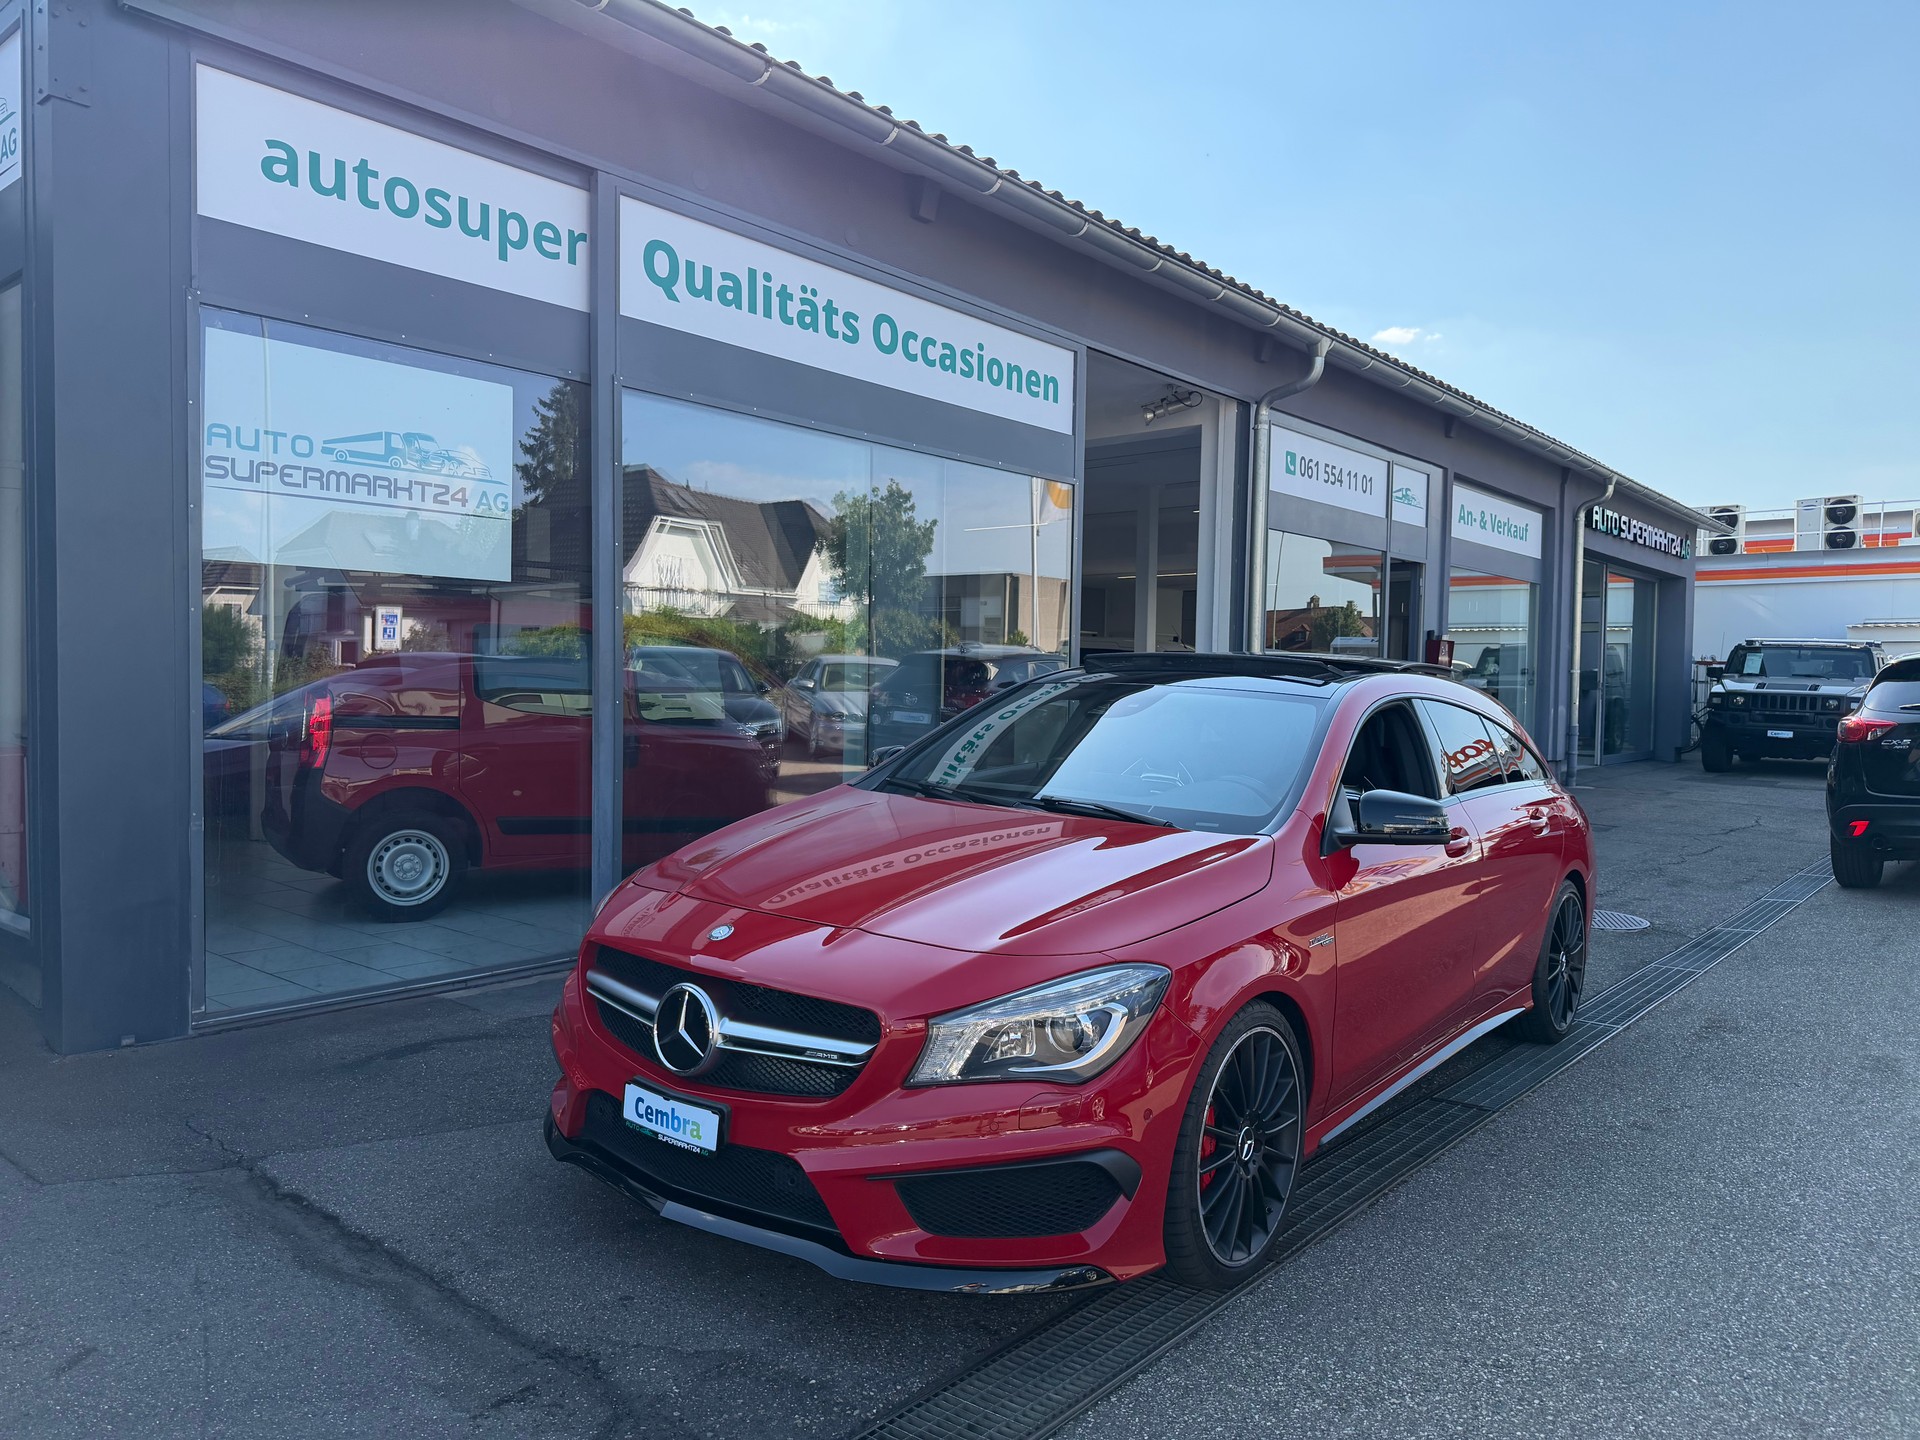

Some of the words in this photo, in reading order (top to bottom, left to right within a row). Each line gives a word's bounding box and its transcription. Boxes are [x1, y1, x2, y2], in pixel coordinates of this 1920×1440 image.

[260, 137, 588, 266] autosuper
[642, 239, 860, 345] Qualitäts
[872, 313, 1060, 404] Occasionen
[206, 422, 314, 459] AUTO
[204, 454, 469, 508] SUPERMARKT24
[475, 490, 509, 513] AG
[1299, 455, 1320, 482] 061
[1323, 463, 1344, 488] 554
[1346, 469, 1359, 492] 11
[1361, 474, 1374, 496] 01
[1458, 503, 1477, 527] An-
[1479, 510, 1488, 531] &
[1490, 513, 1529, 542] Verkauf
[1592, 505, 1620, 536] AUTO
[1620, 515, 1681, 557] SUPERMARKT24
[1681, 538, 1691, 560] AG
[815, 1052, 838, 1060] AMG
[625, 1120, 640, 1131] AUTO
[634, 1096, 703, 1141] Cembra
